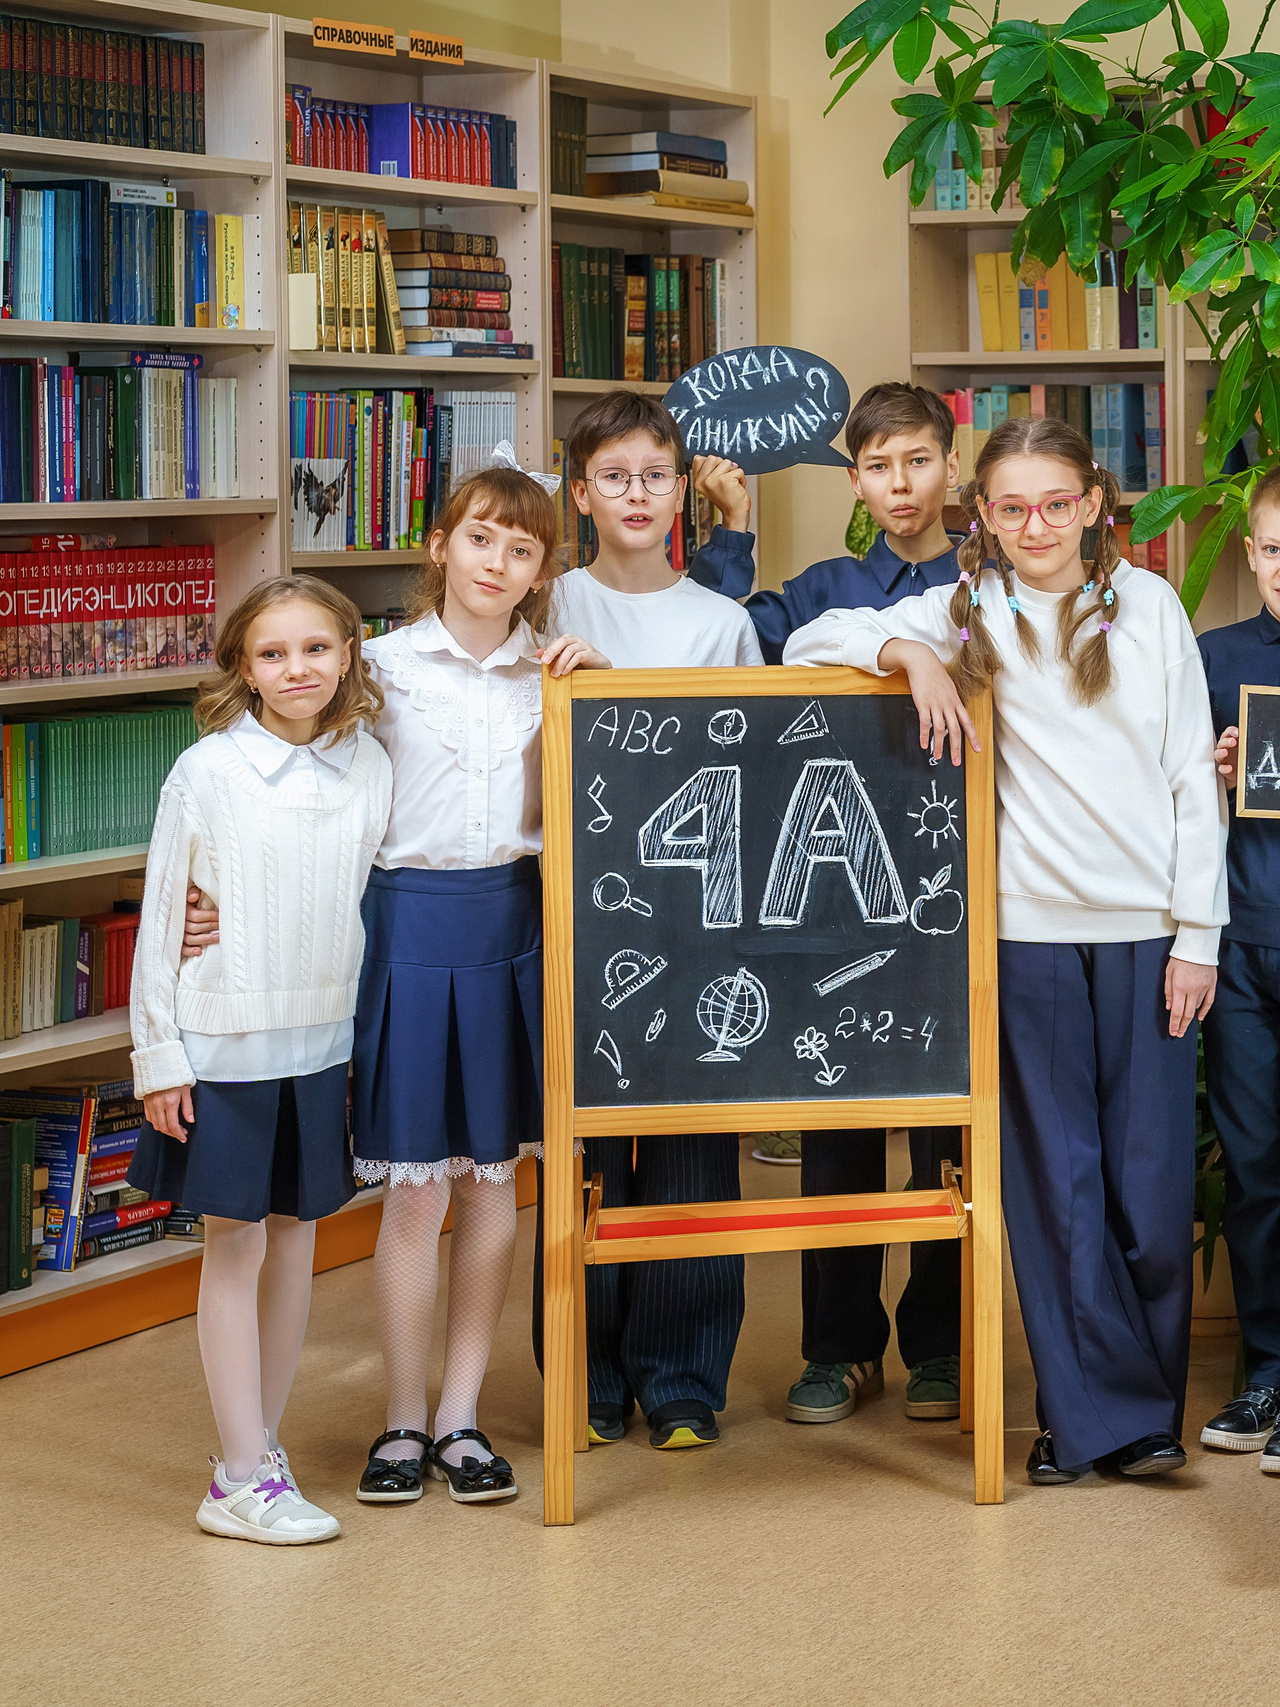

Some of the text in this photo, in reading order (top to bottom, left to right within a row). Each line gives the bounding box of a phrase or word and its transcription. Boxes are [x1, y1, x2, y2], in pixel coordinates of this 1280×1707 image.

[314, 24, 463, 60] СПРАВОЧНЫЕ ИЗДАНИЯ
[681, 346, 799, 409] КОГДА
[41, 537, 50, 550] 15
[8, 567, 16, 579] 10
[21, 566, 28, 578] 11
[30, 566, 39, 578] 12
[42, 565, 50, 577] 13
[53, 565, 61, 576] 14
[75, 564, 83, 576] 16
[95, 563, 104, 575] 18
[107, 562, 115, 574] 19
[587, 706, 681, 755] ABC
[127, 1207, 154, 1221] СЛОВАРЬ
